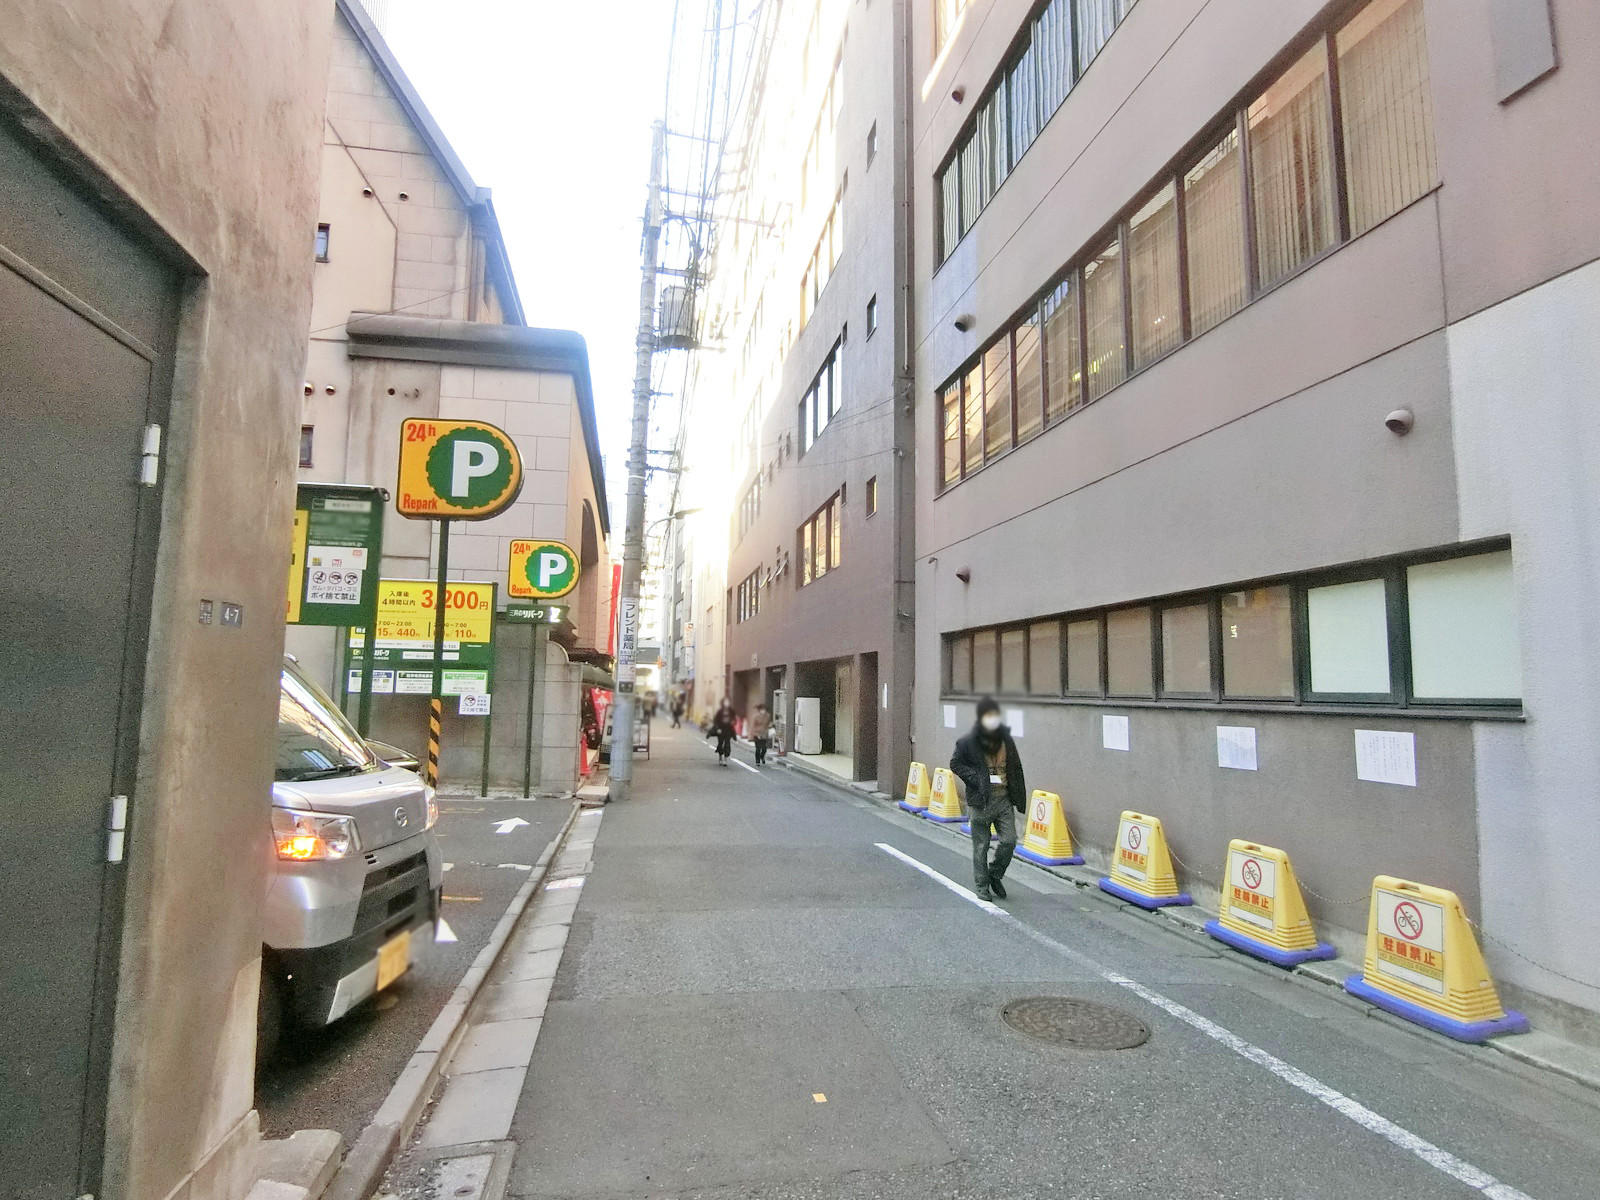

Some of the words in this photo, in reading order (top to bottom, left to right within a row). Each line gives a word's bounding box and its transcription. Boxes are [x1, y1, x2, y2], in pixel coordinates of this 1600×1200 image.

[407, 423, 436, 442] 24h
[451, 440, 499, 498] P
[403, 494, 437, 511] Repark
[513, 543, 531, 554] 24h
[539, 552, 568, 587] P
[382, 598, 416, 606] 4時間以内
[389, 590, 410, 598] 入庫後
[224, 607, 240, 623] 4-7
[622, 603, 636, 650] フレンド薬局
[1234, 887, 1270, 910] 駐輪禁止
[1383, 937, 1436, 967] 駐輪禁止
